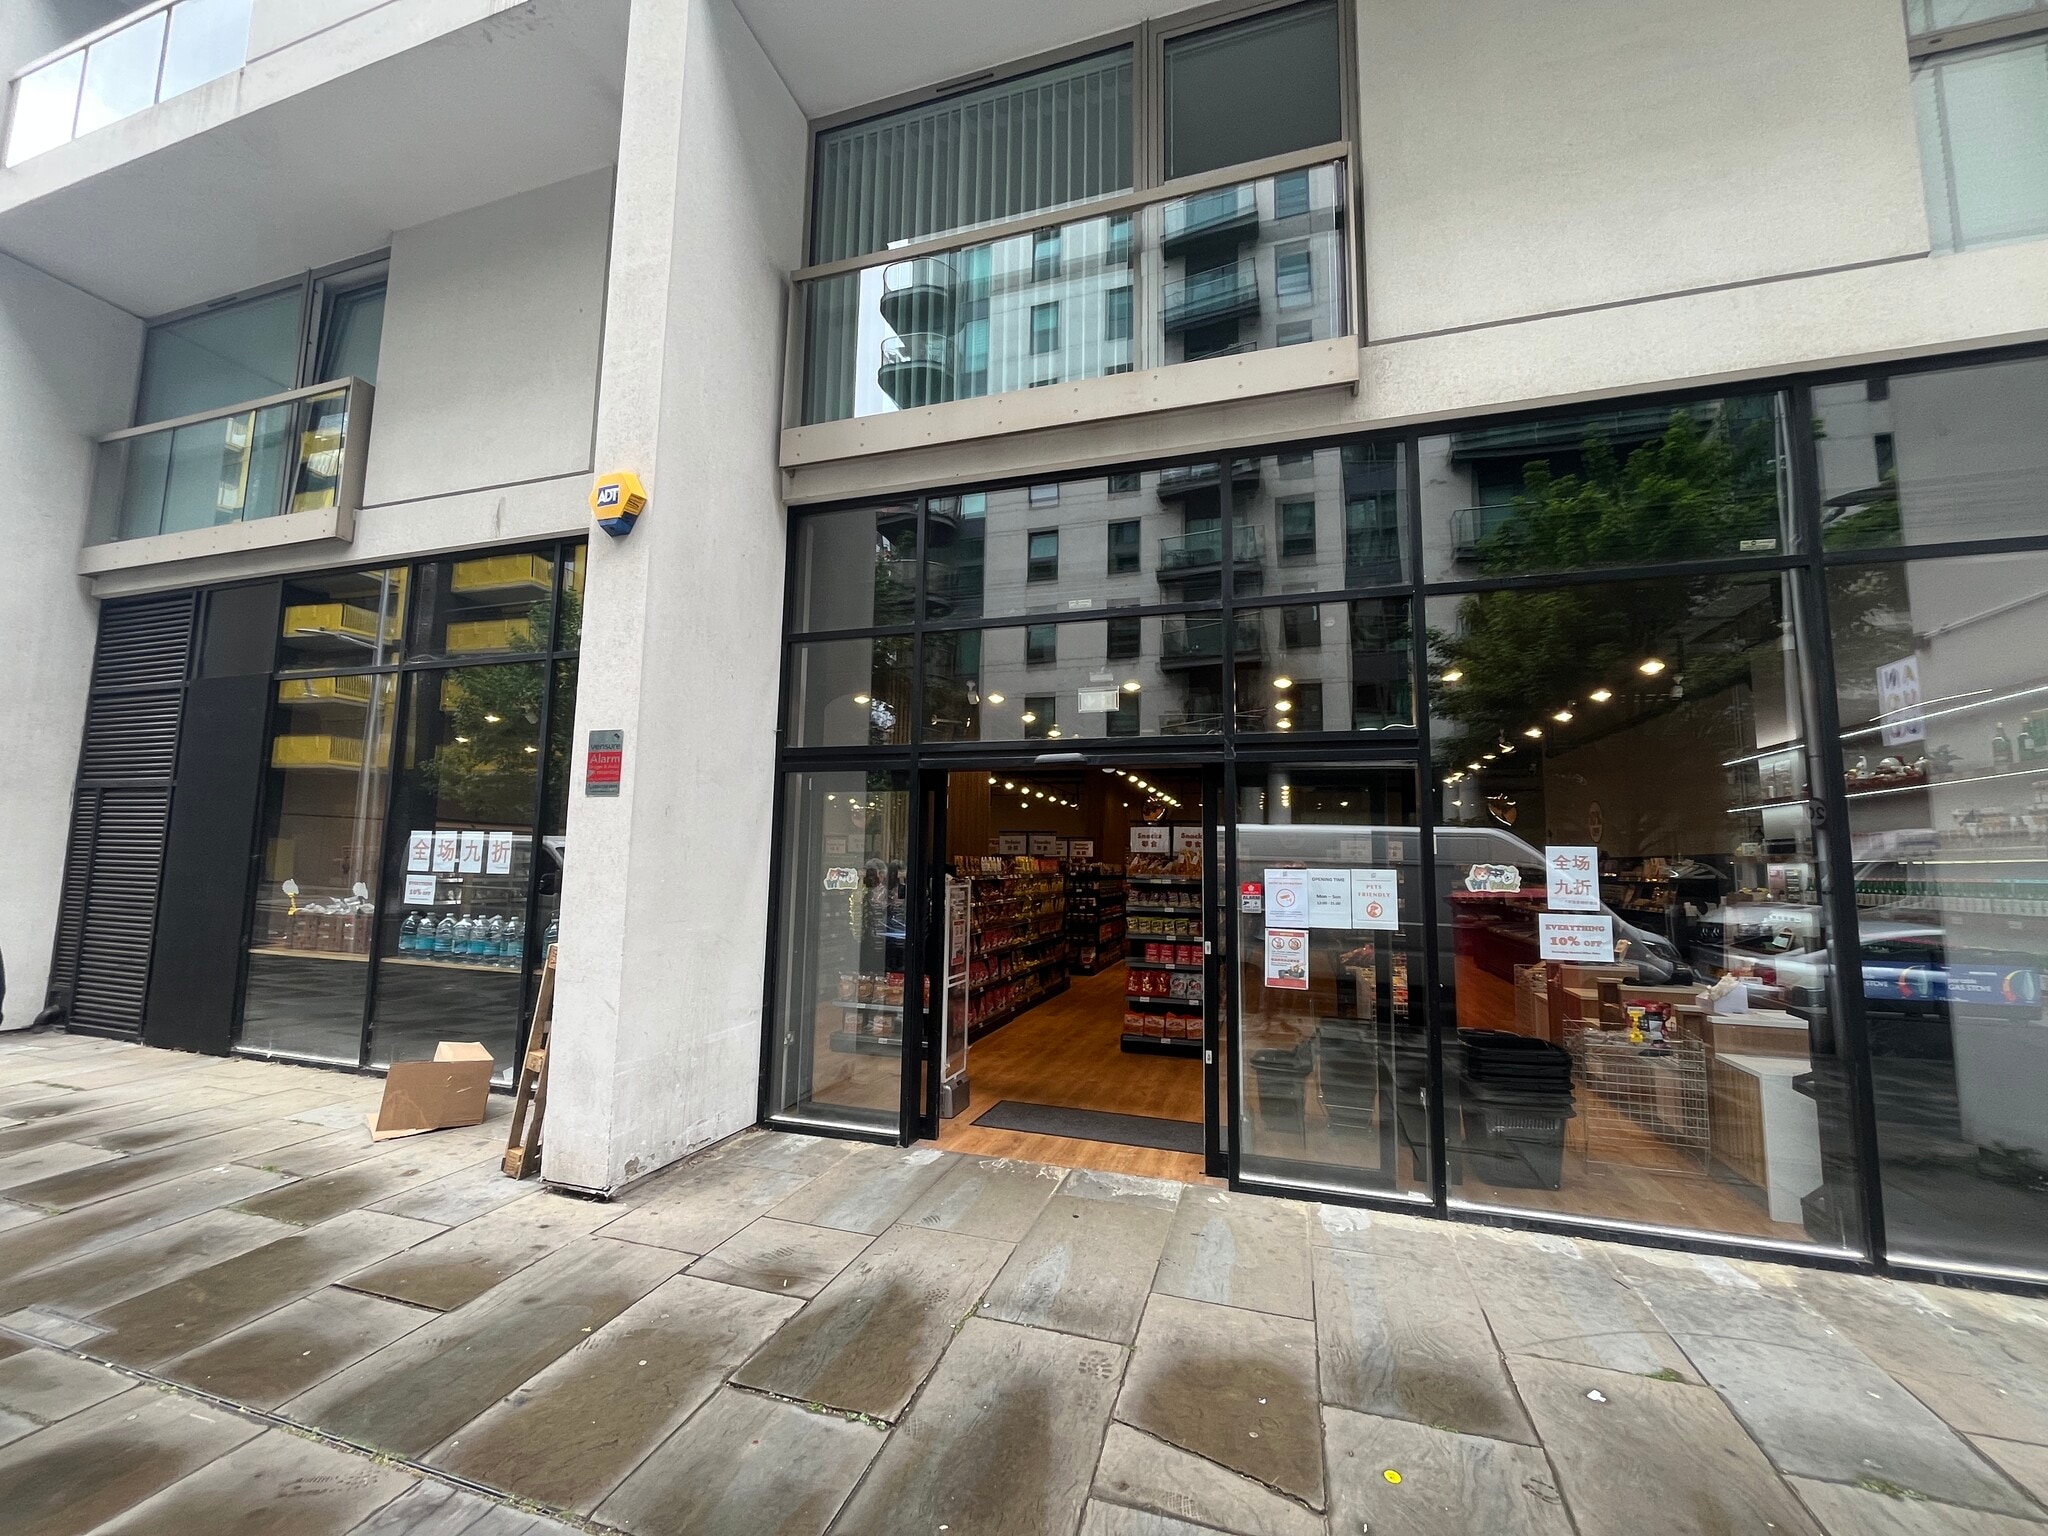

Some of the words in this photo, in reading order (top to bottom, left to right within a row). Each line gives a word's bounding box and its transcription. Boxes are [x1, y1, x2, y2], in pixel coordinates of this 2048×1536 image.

[597, 488, 619, 504] ADT
[591, 753, 620, 764] Alarm
[1553, 855, 1590, 871] 全场
[1555, 879, 1592, 896] 九折
[1545, 924, 1605, 932] EVERYTHING
[1550, 936, 1580, 946] 10%
[1966, 984, 1992, 992] STOVE
